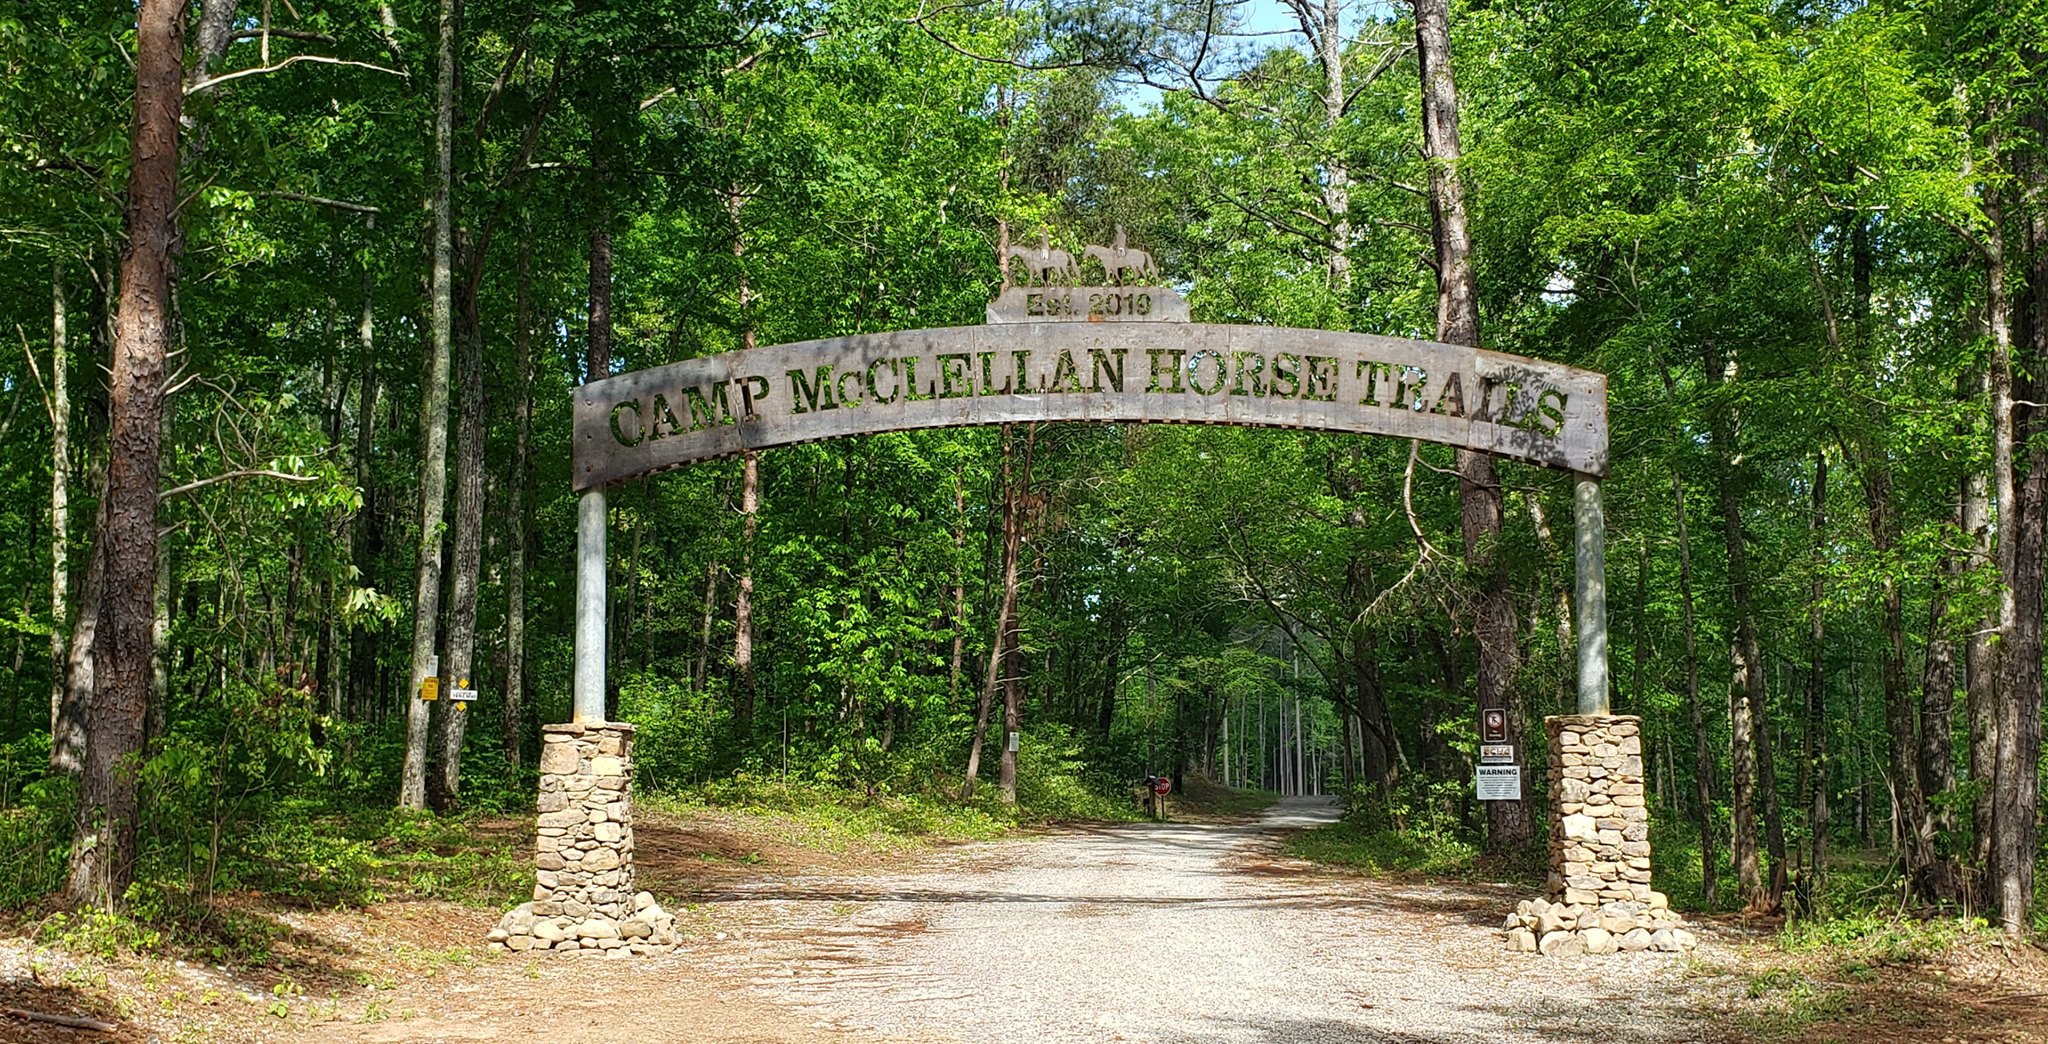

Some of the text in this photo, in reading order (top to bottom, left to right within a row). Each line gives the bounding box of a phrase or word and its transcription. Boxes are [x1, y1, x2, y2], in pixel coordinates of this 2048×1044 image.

[1026, 293, 1152, 316] Est. 2019
[609, 347, 1568, 448] CAMP McCLELLAN HORSE TRAILS
